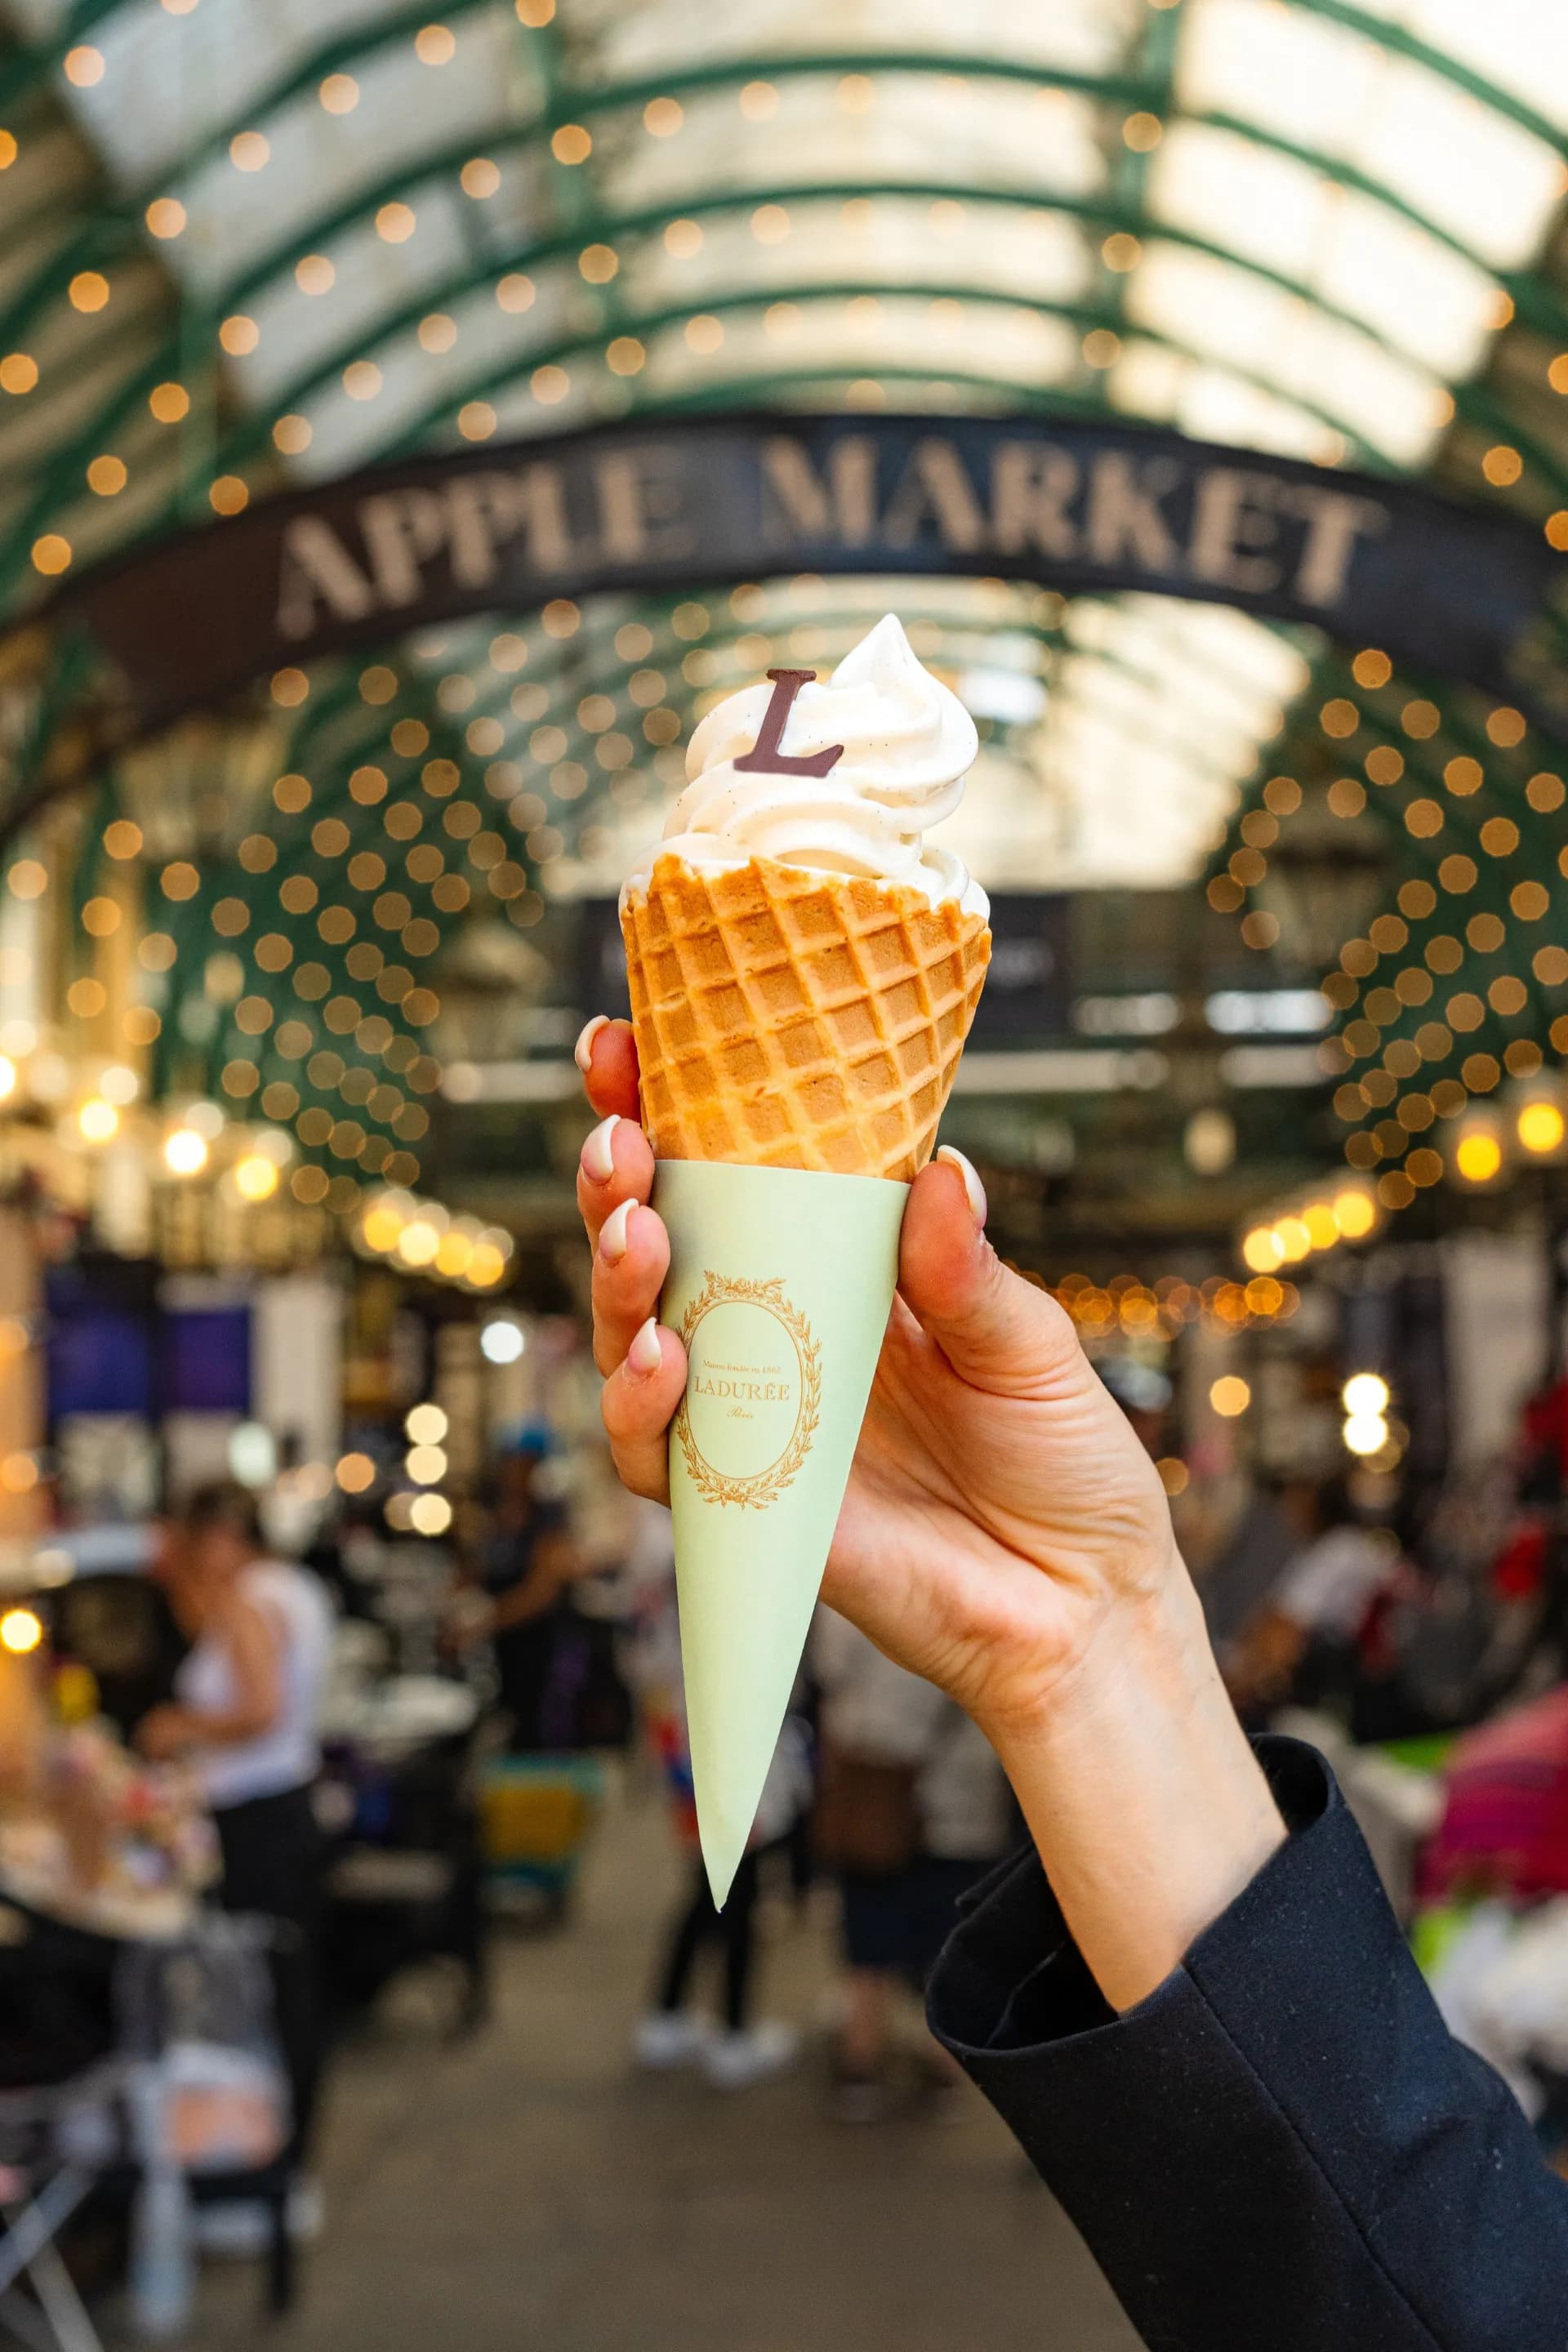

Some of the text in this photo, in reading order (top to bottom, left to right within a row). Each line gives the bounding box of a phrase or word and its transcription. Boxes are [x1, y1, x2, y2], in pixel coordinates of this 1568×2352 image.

[274, 434, 1388, 642] APPLE MARKET
[733, 668, 844, 779] L
[693, 1376, 790, 1400] LADURÉE
